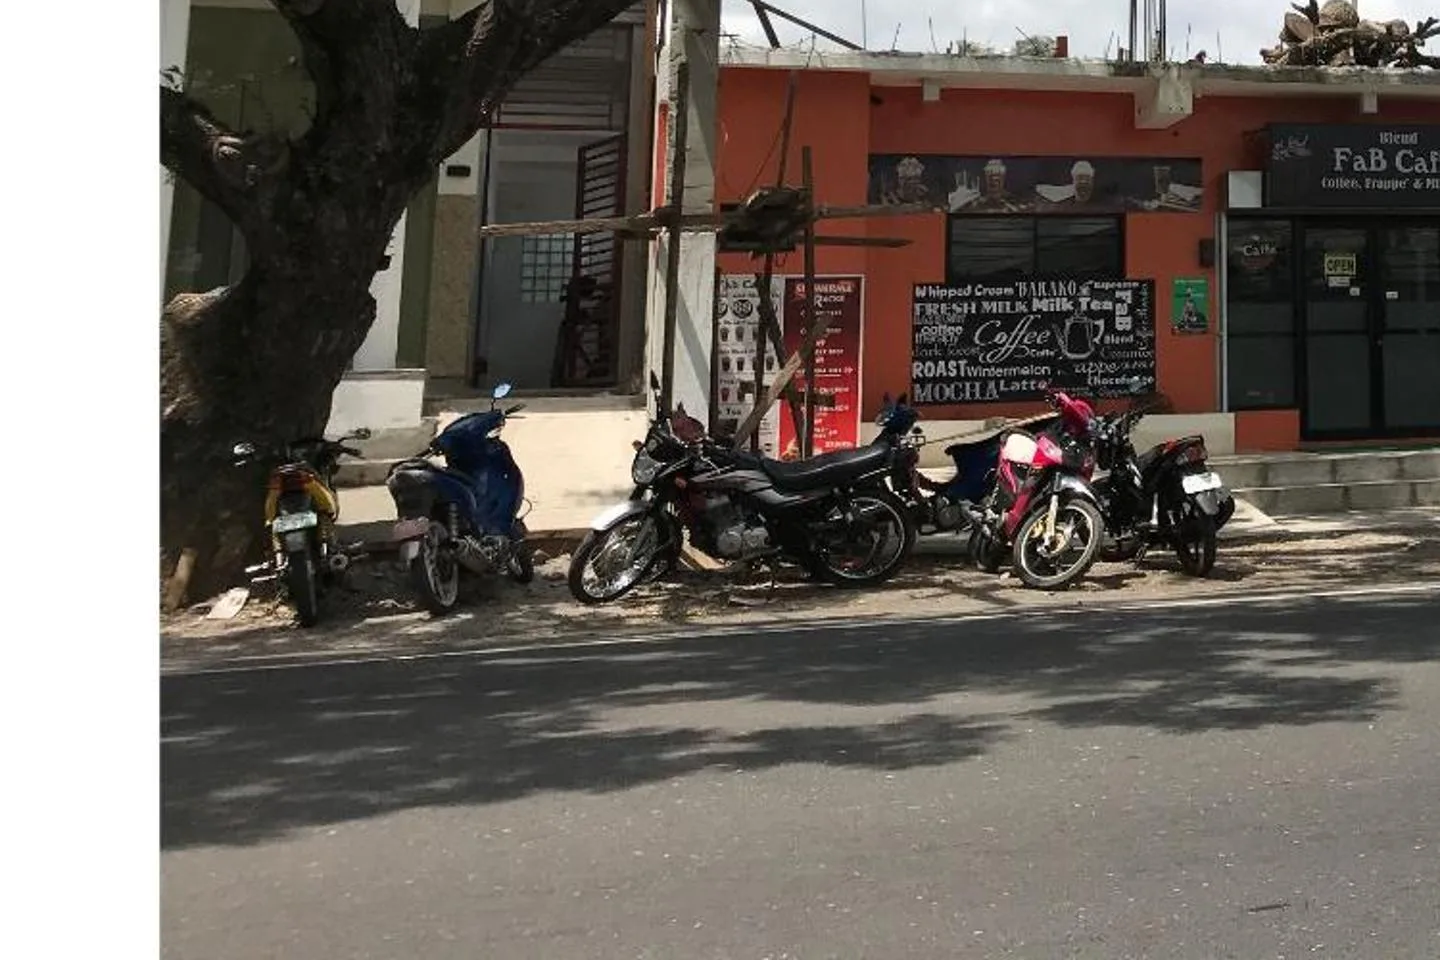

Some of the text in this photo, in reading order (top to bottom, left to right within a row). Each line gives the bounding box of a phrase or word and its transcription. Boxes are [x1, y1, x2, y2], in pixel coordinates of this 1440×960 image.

[1333, 147, 1388, 173] FaB
[1412, 178, 1425, 190] &
[1326, 257, 1354, 273] OPEN
[915, 284, 973, 298] Whipped
[914, 300, 1029, 315] FRESH MILK
[1032, 297, 1114, 312] Milk Tea
[1115, 289, 1132, 331] FaB
[973, 313, 1052, 364] Coffee
[912, 359, 968, 379] ROAST
[967, 364, 1052, 378] Wintermelon
[914, 380, 1000, 402] MOCHA
